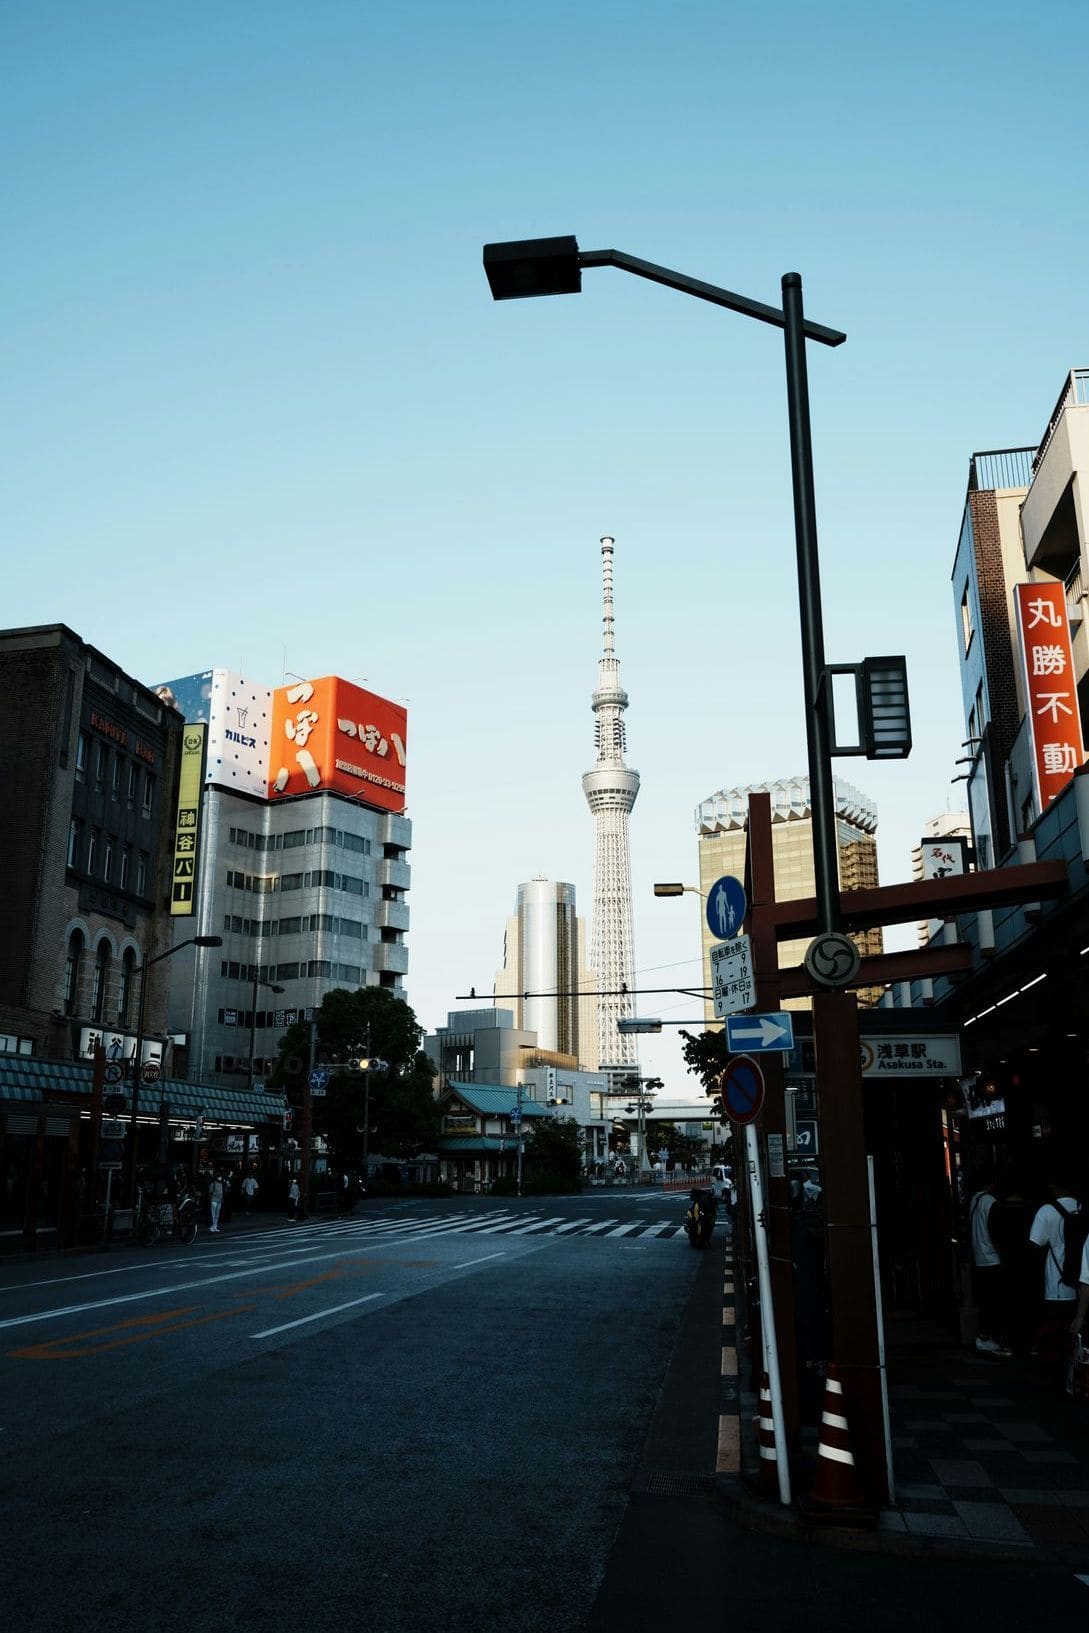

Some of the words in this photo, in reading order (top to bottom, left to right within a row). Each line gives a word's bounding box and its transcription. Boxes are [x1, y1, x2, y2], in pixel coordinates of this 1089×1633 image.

[1027, 597, 1077, 800] 丸勝不動
[225, 728, 257, 749] カルピス
[175, 811, 195, 896] 神谷バー
[711, 940, 748, 962] 自転車を除く
[714, 962, 720, 974] 7
[741, 953, 746, 964] 9
[715, 974, 724, 986] 16
[740, 966, 748, 978] 19
[718, 1001, 723, 1012] 9
[742, 991, 750, 1005] 17
[877, 1043, 927, 1059] 浅草駅
[878, 1059, 923, 1070] Asakusa
[926, 1059, 947, 1069] Sta.
